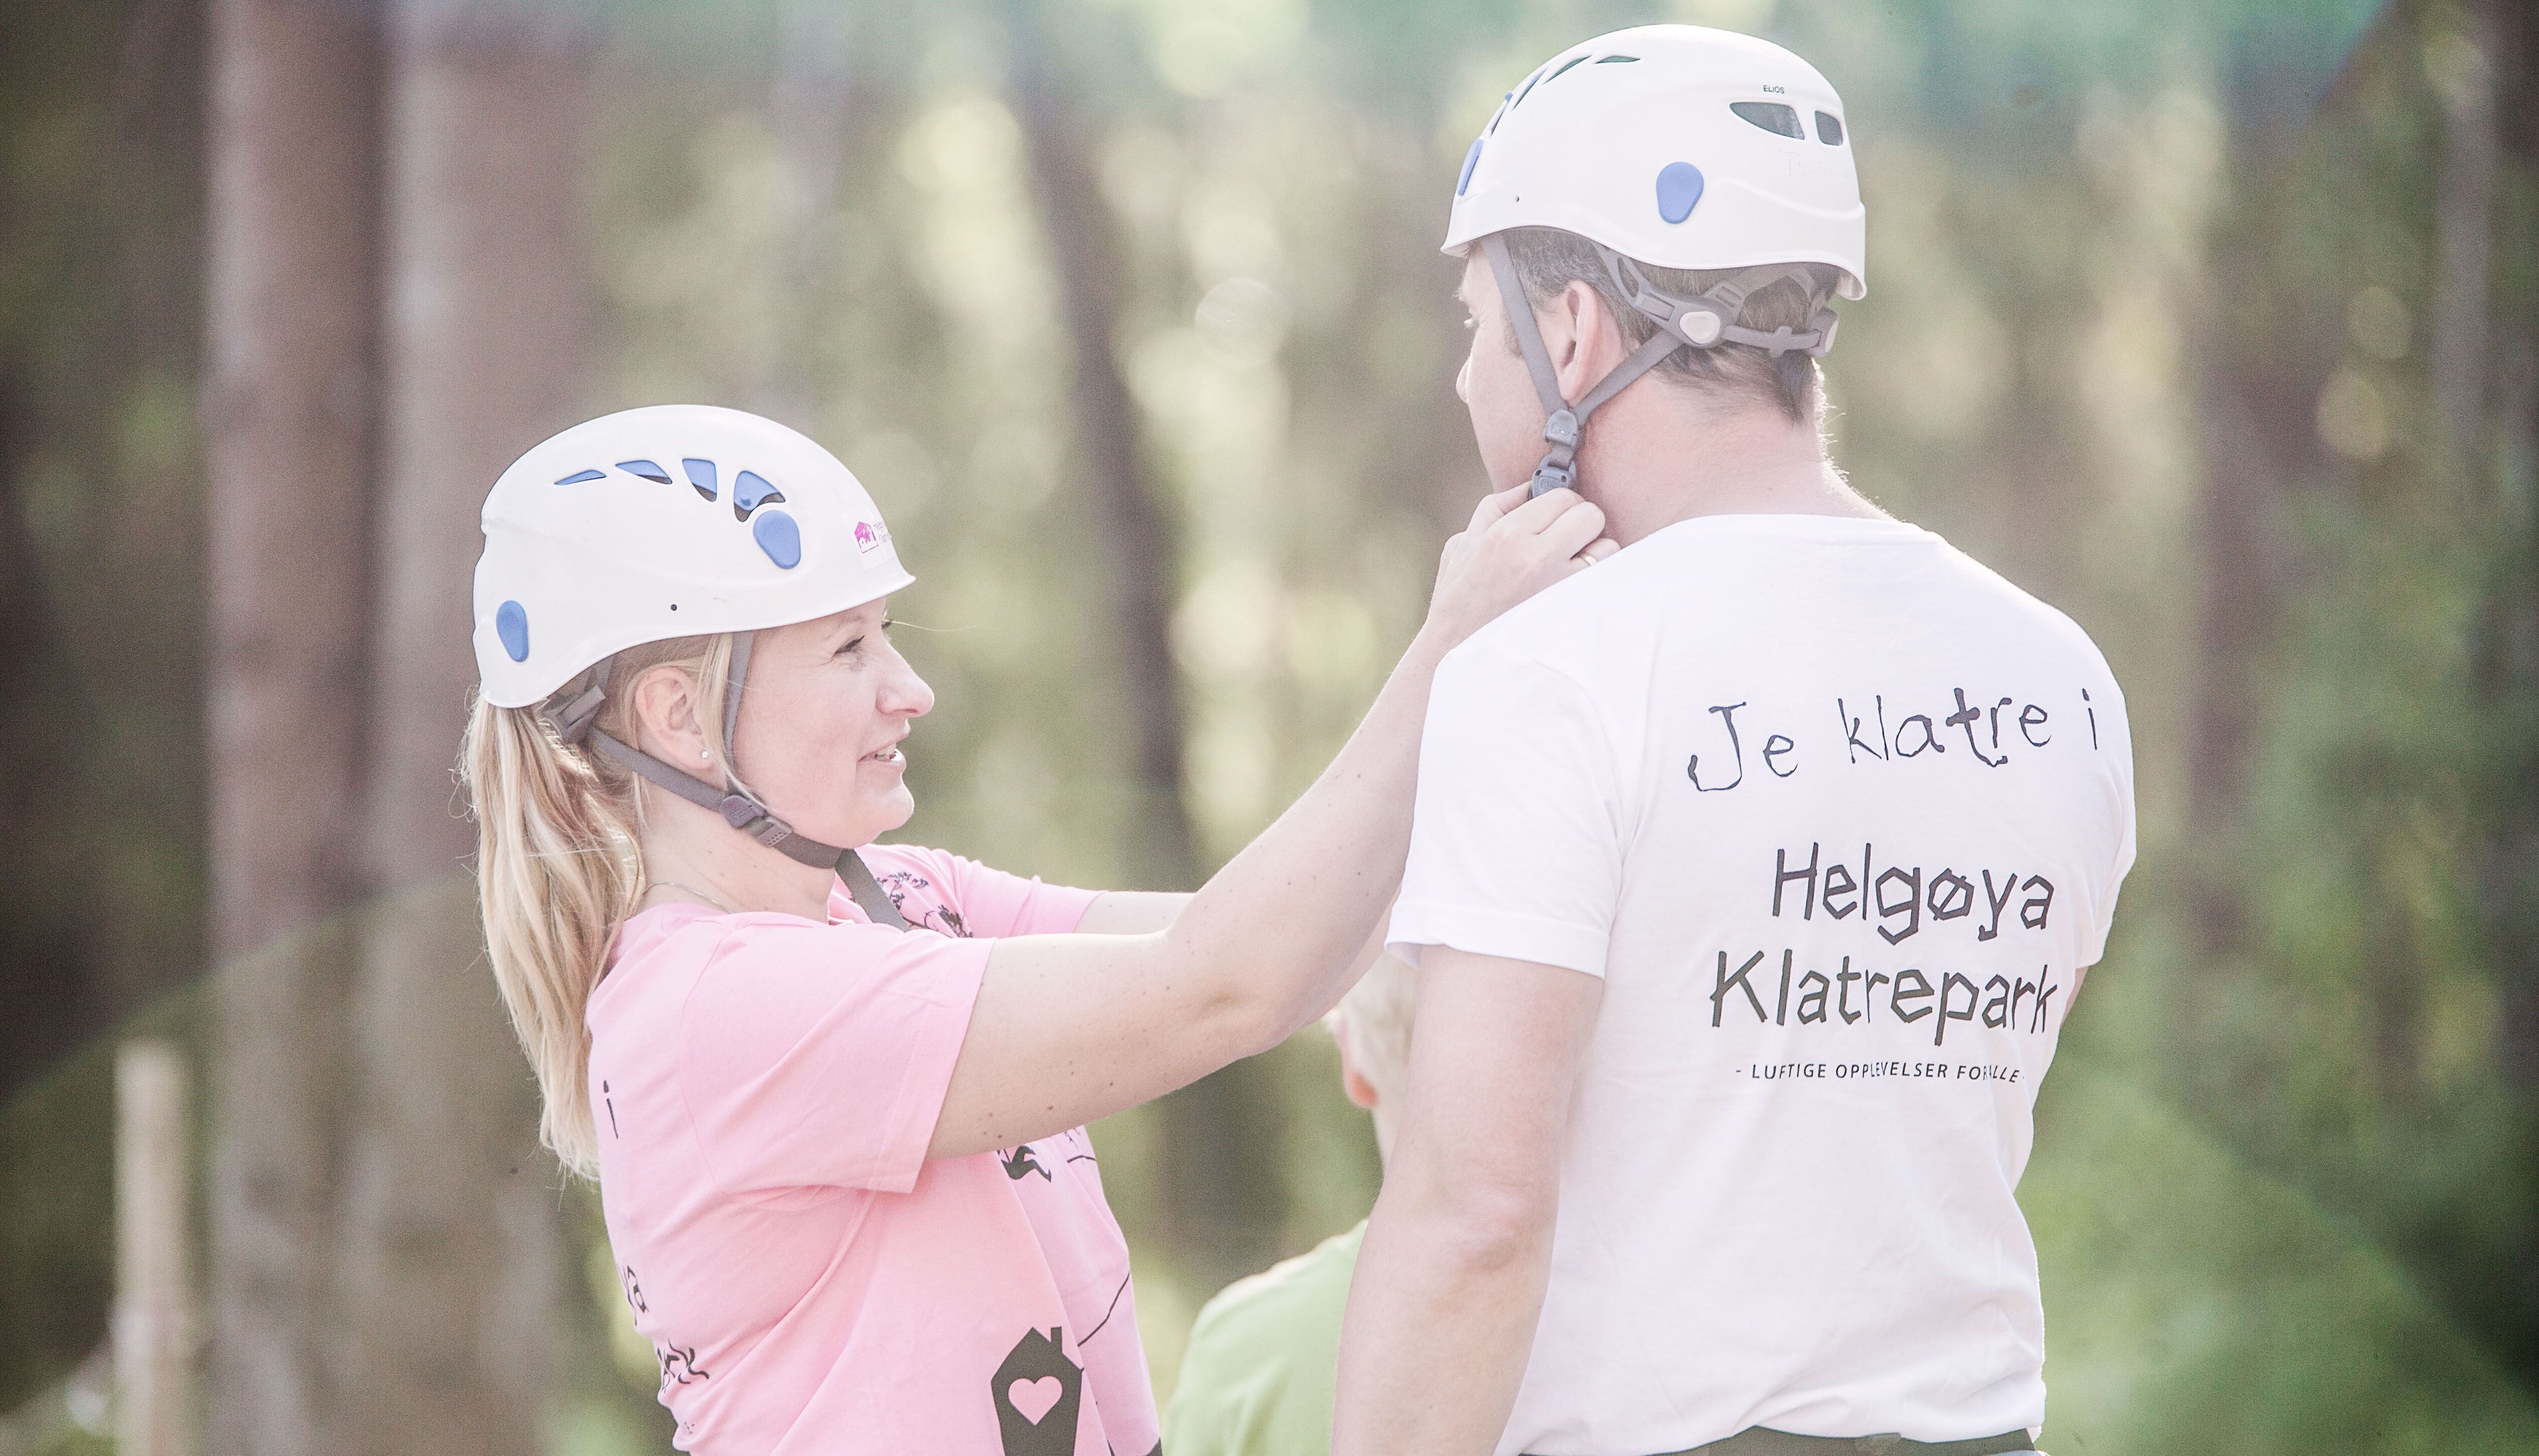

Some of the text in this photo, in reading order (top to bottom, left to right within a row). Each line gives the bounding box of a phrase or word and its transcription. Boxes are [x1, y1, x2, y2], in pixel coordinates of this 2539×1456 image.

[1763, 85, 1785, 94] ELIOS
[1688, 687, 2097, 792] Je klatre i
[1772, 842, 2054, 945] Helgøya
[1709, 949, 2057, 1047] Klatrepark
[1752, 1063, 1827, 1079] LUFTIGE
[1835, 1061, 1948, 1079] OPPLEVELSER
